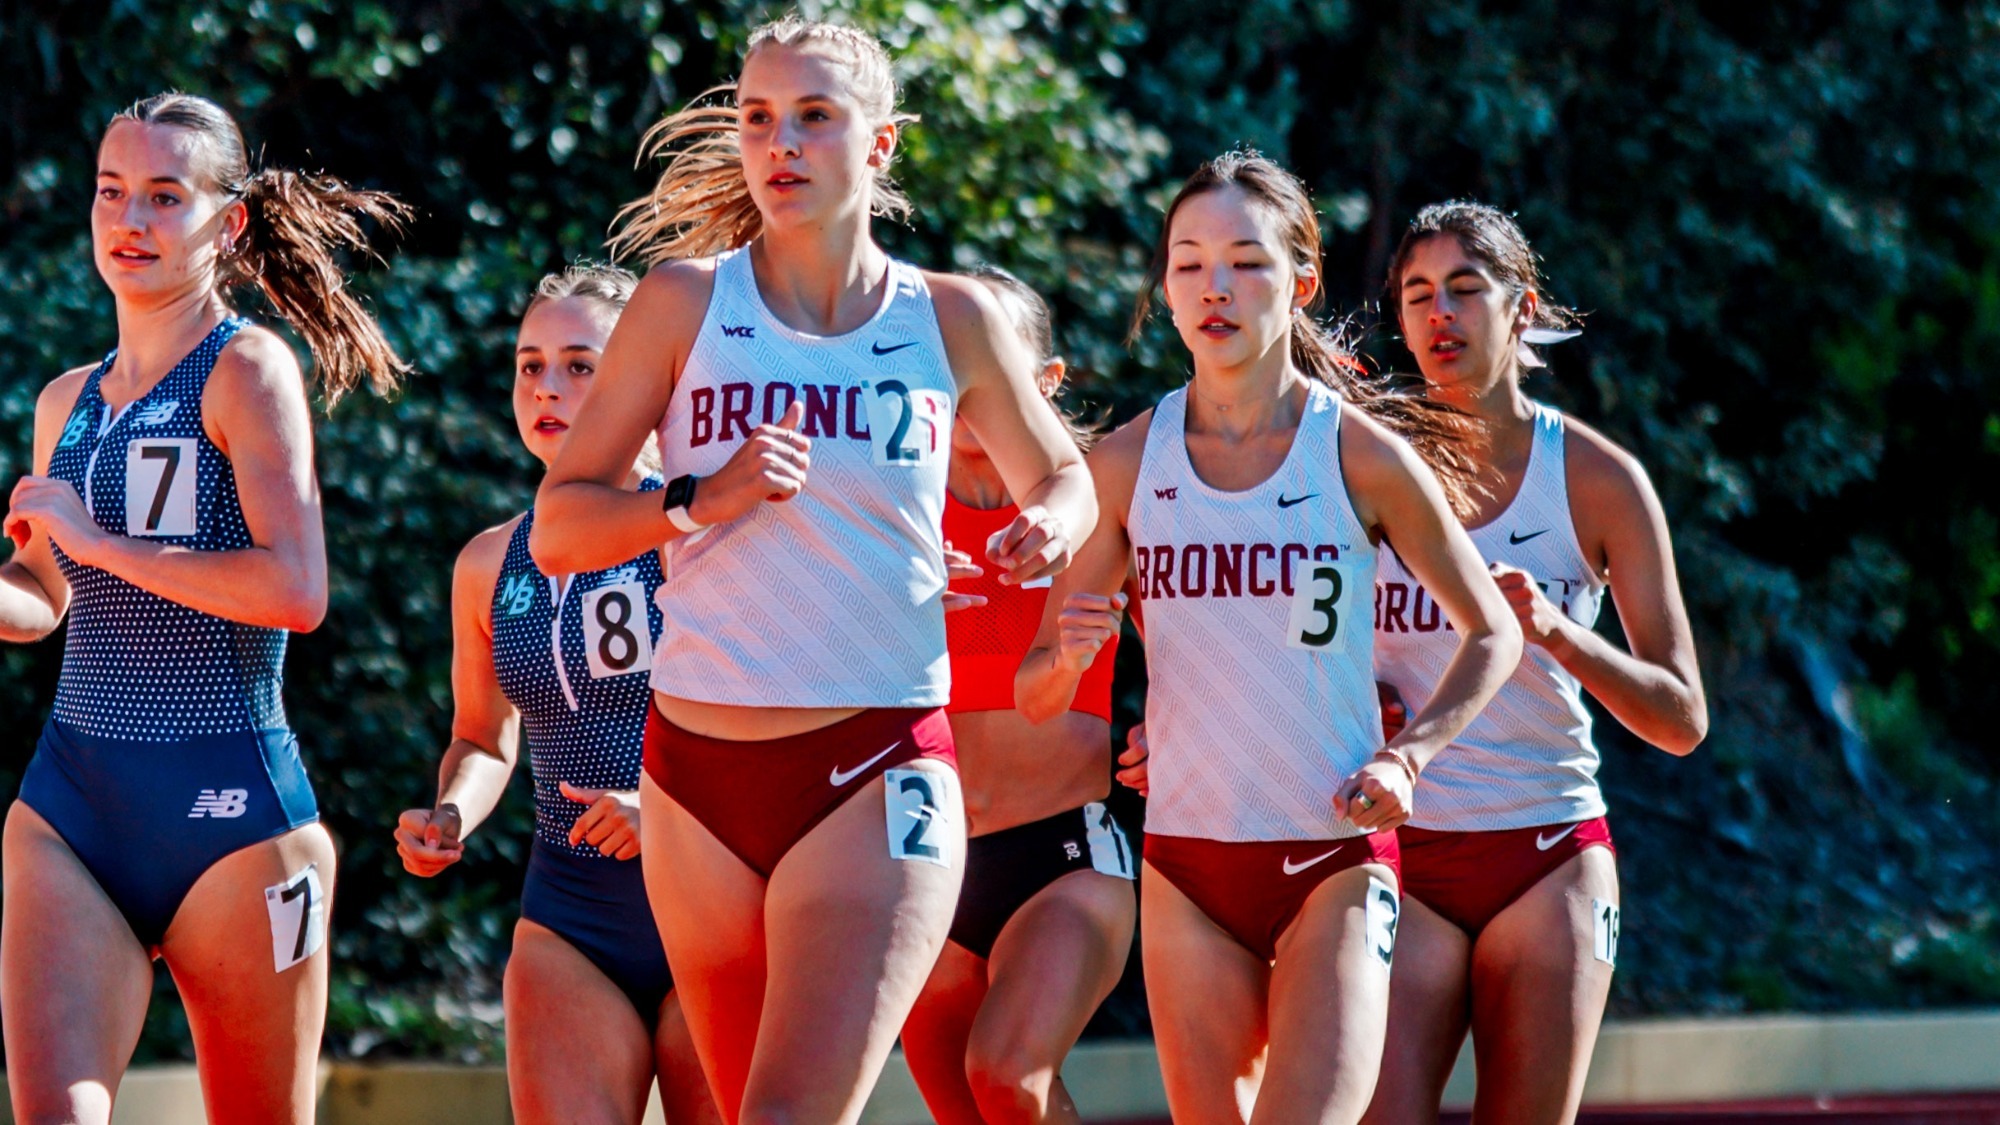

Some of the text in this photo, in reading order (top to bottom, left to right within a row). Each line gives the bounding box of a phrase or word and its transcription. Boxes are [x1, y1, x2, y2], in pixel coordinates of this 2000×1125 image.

[690, 380, 937, 454] BRONC
[875, 379, 920, 462] 2
[141, 446, 181, 531] 7
[500, 573, 535, 616] MB
[1136, 543, 1339, 600] BRONCO
[1300, 566, 1343, 647] 3
[596, 590, 639, 671] 8
[188, 788, 249, 818] NB
[900, 775, 940, 859] 2
[280, 875, 312, 962] 7
[1378, 889, 1397, 965] 3
